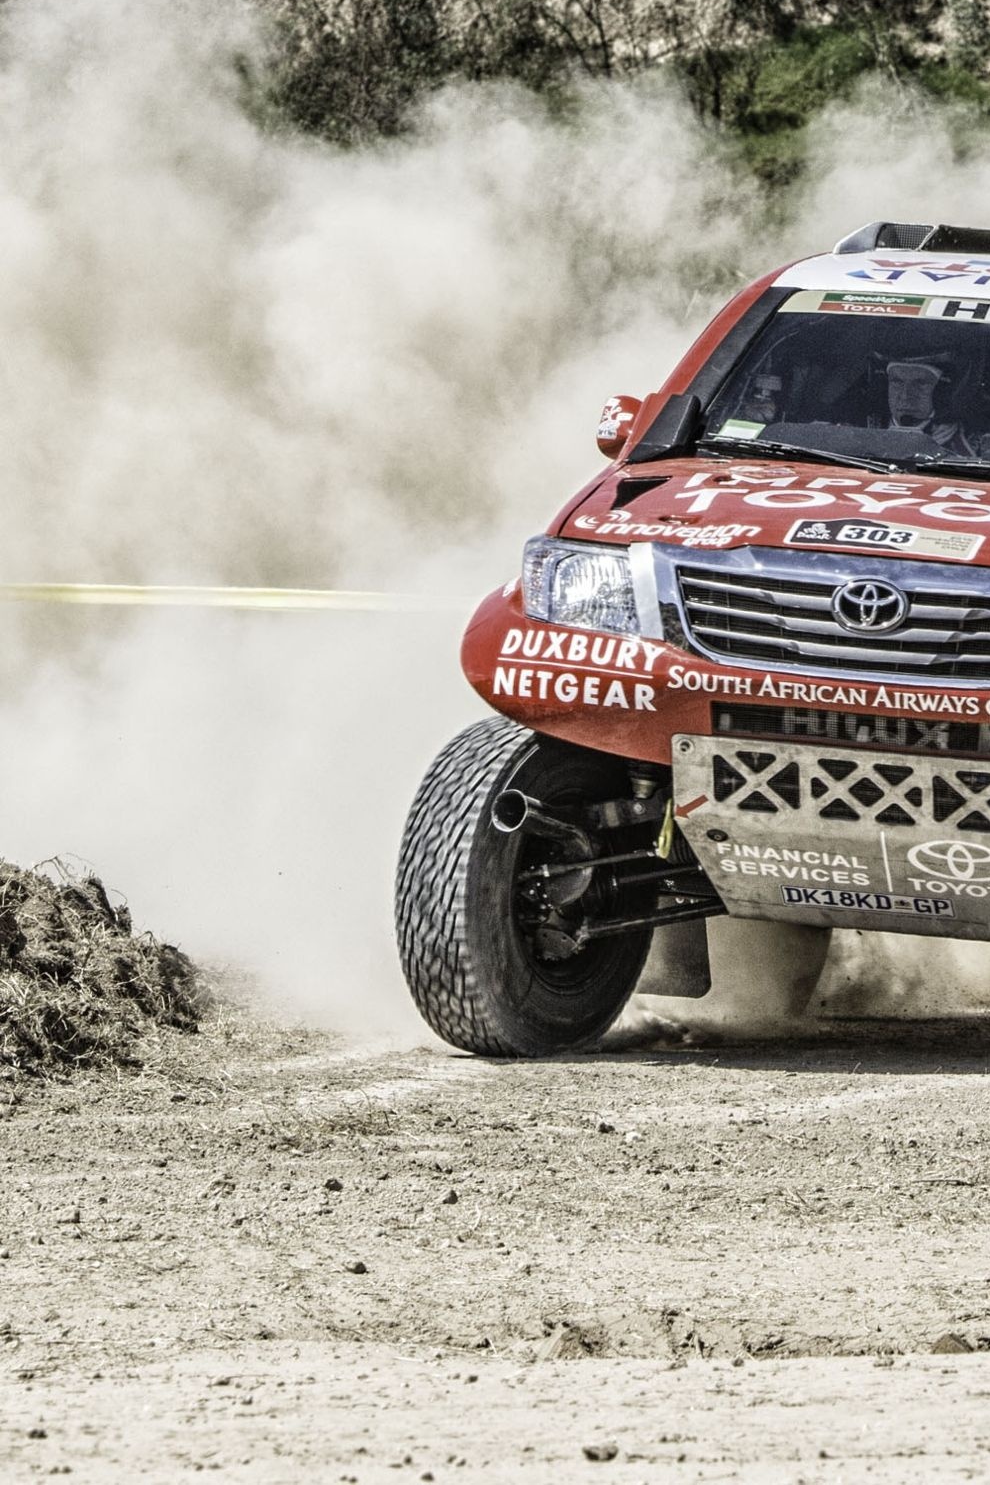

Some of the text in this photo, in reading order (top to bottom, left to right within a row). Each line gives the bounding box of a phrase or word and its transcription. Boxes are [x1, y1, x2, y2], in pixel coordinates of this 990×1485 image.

[844, 526, 913, 544] 303
[500, 628, 668, 672] DUXBURY
[493, 667, 658, 712] NETGEAR
[667, 665, 752, 696] SOUTH
[757, 674, 868, 707] AFRICAN
[870, 686, 980, 717] AIRWAYS
[716, 842, 870, 871] FINANCIAL
[720, 858, 871, 887] SERVICES
